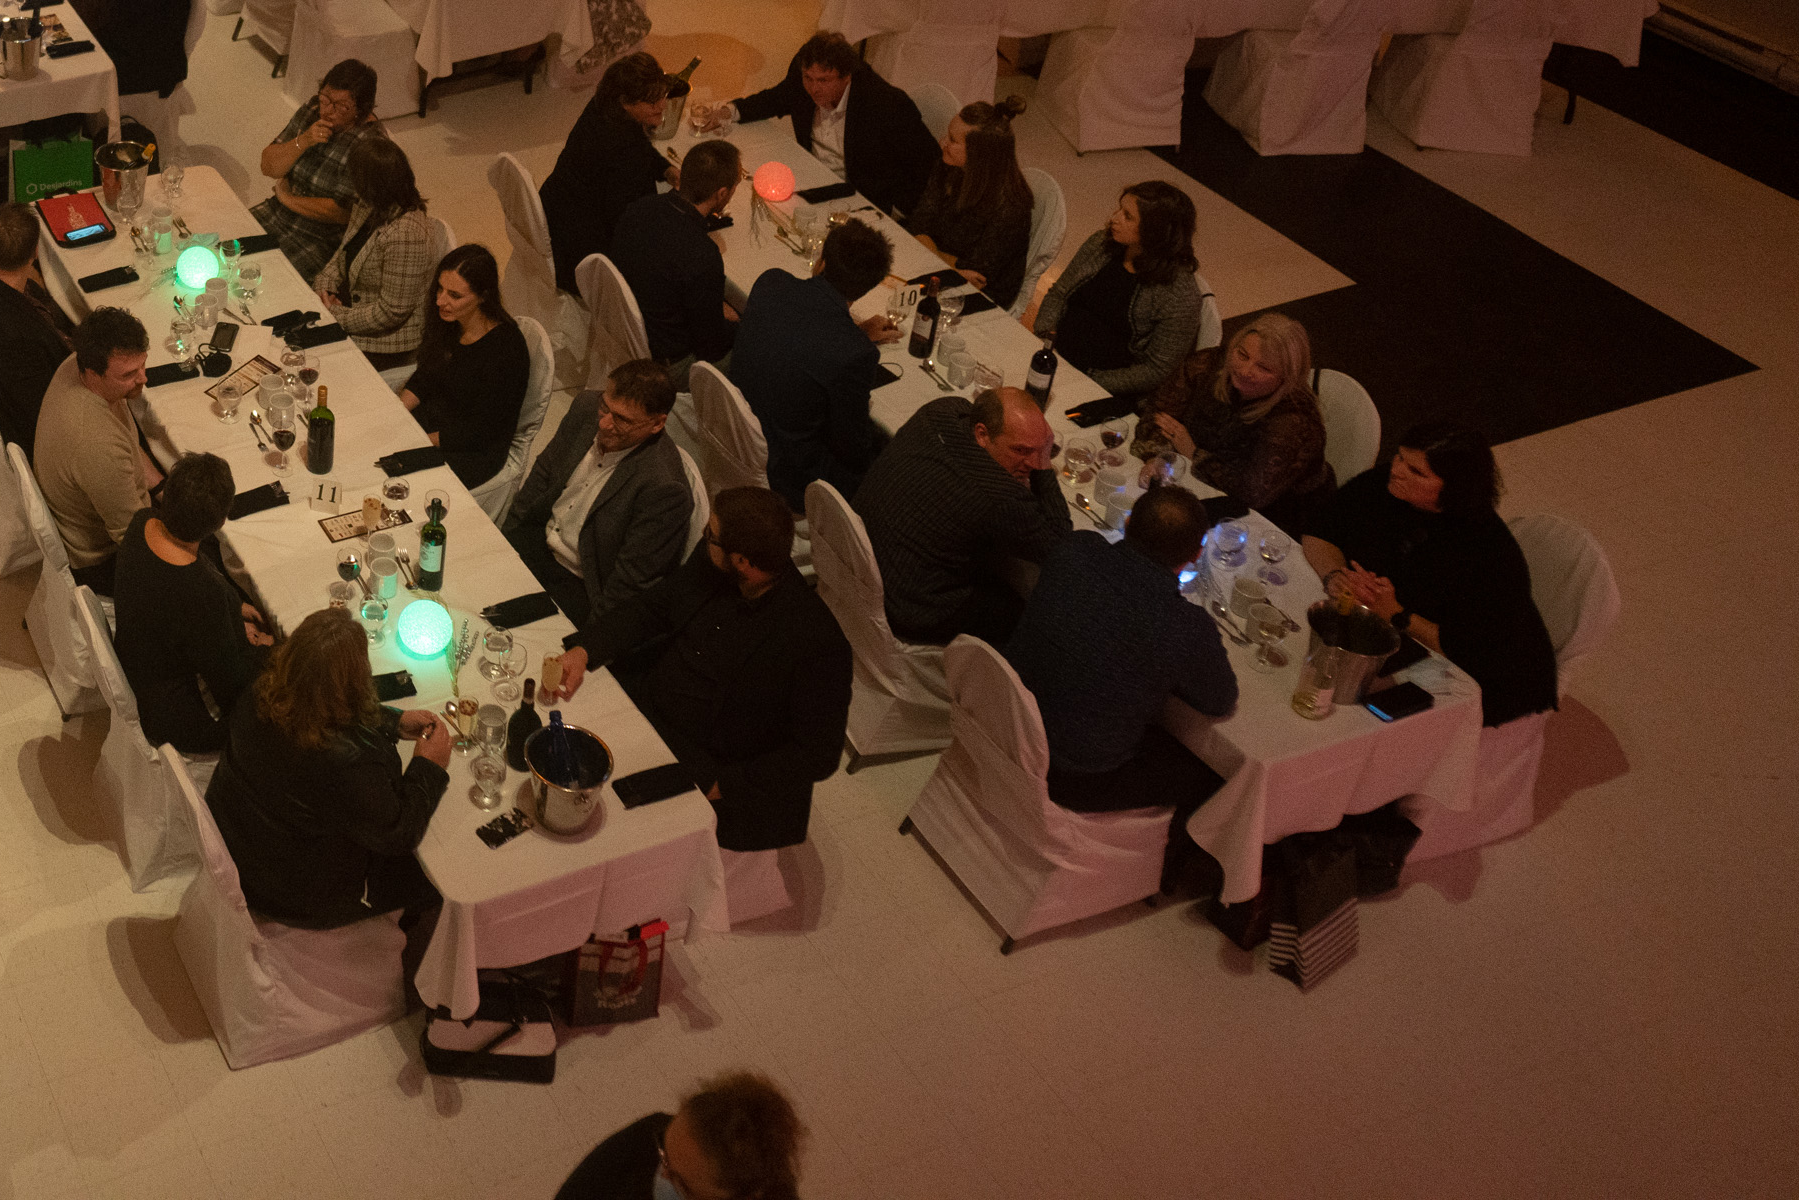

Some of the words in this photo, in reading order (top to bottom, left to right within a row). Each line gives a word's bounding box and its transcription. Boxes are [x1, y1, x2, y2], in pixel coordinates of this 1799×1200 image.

[39, 179, 83, 192] Desjardins
[899, 289, 918, 307] 10
[316, 483, 337, 504] 11
